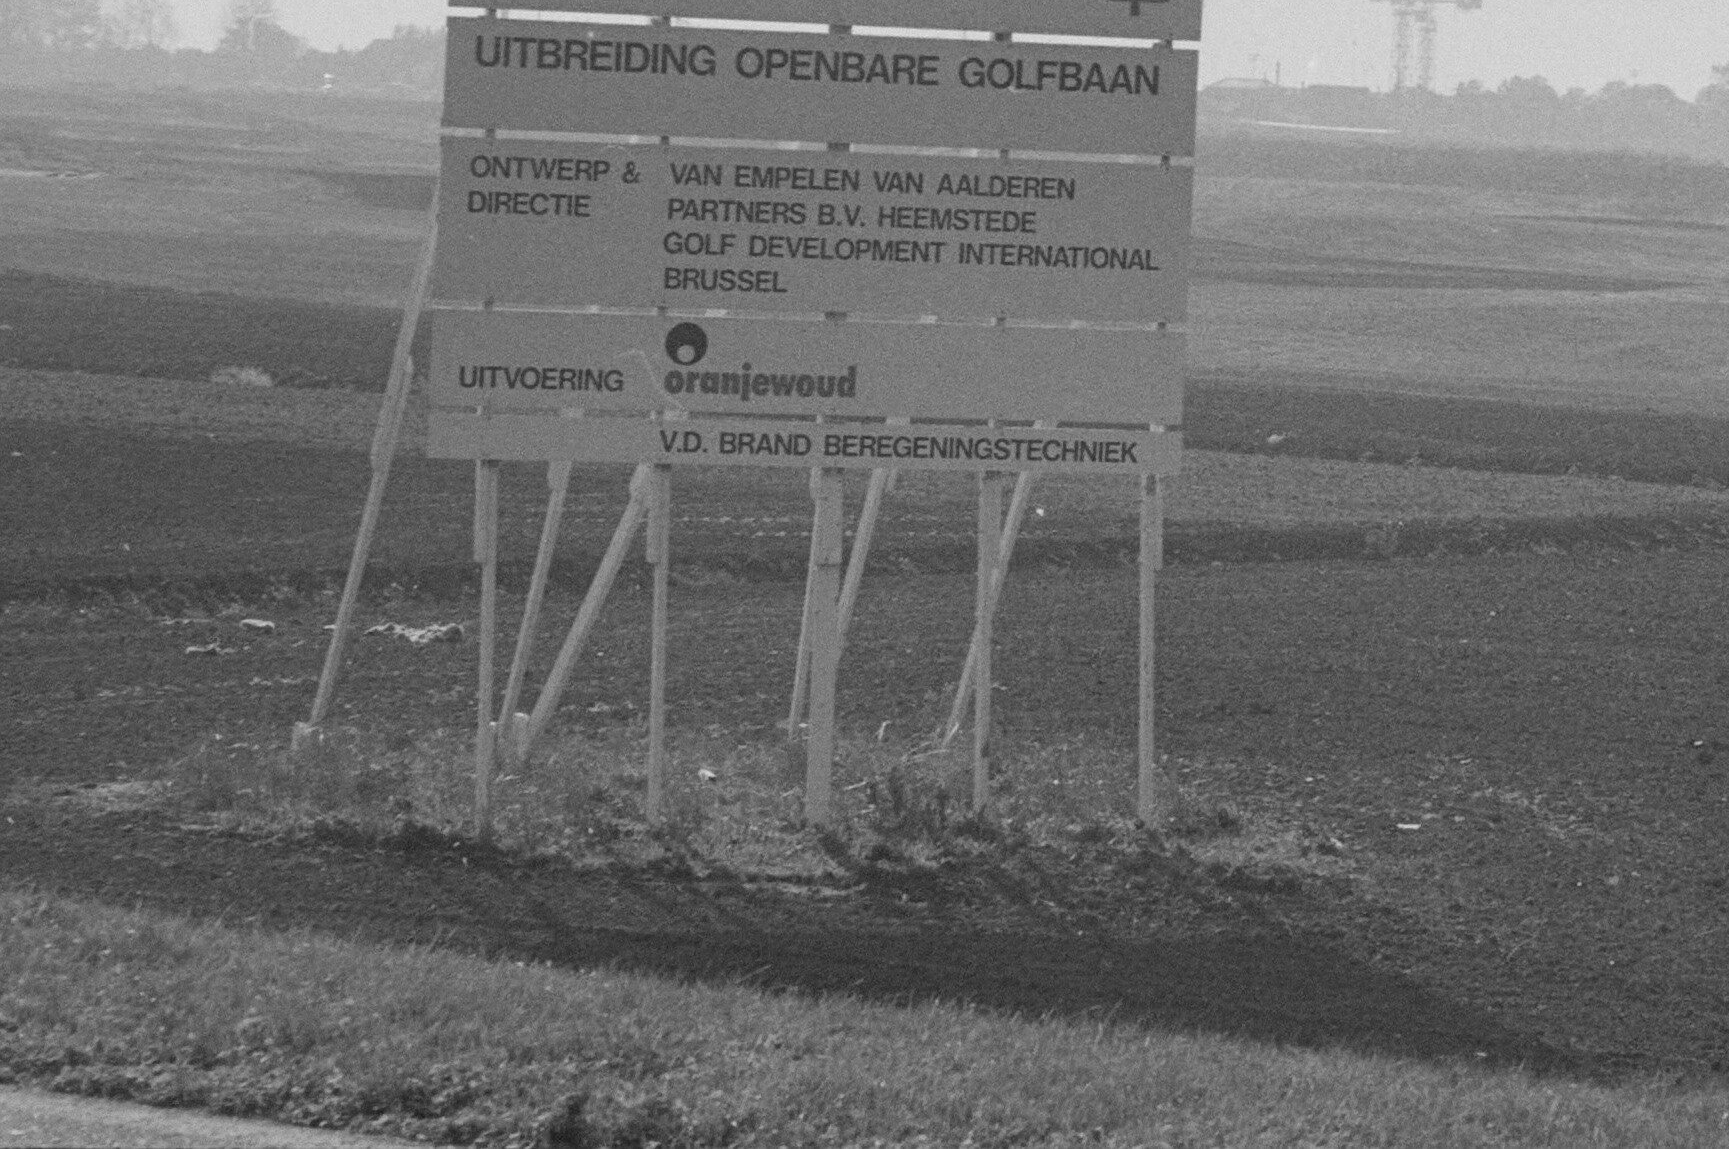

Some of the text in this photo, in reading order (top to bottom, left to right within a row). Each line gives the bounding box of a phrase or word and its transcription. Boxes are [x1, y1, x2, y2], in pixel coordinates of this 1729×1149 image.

[475, 35, 1160, 95] UITBREIDING OPENBARE GOLFBAAN
[470, 154, 641, 184] ONTWERP &
[669, 163, 1076, 200] VAN EMPELEN VAN AALDEREN
[467, 190, 592, 217] DIRECTIE
[667, 198, 1037, 233] PARTNERS B.V. HEEMSTEDE
[663, 231, 1161, 271] GOLF DEVELOPMENT INTERNATIONAL
[663, 267, 788, 293] BRUSSEL
[458, 365, 625, 392] UITVOERING
[664, 362, 858, 401] oranjewoud
[659, 429, 1138, 464] V.D. BRAND BEREGENINGSTECHNIEK
